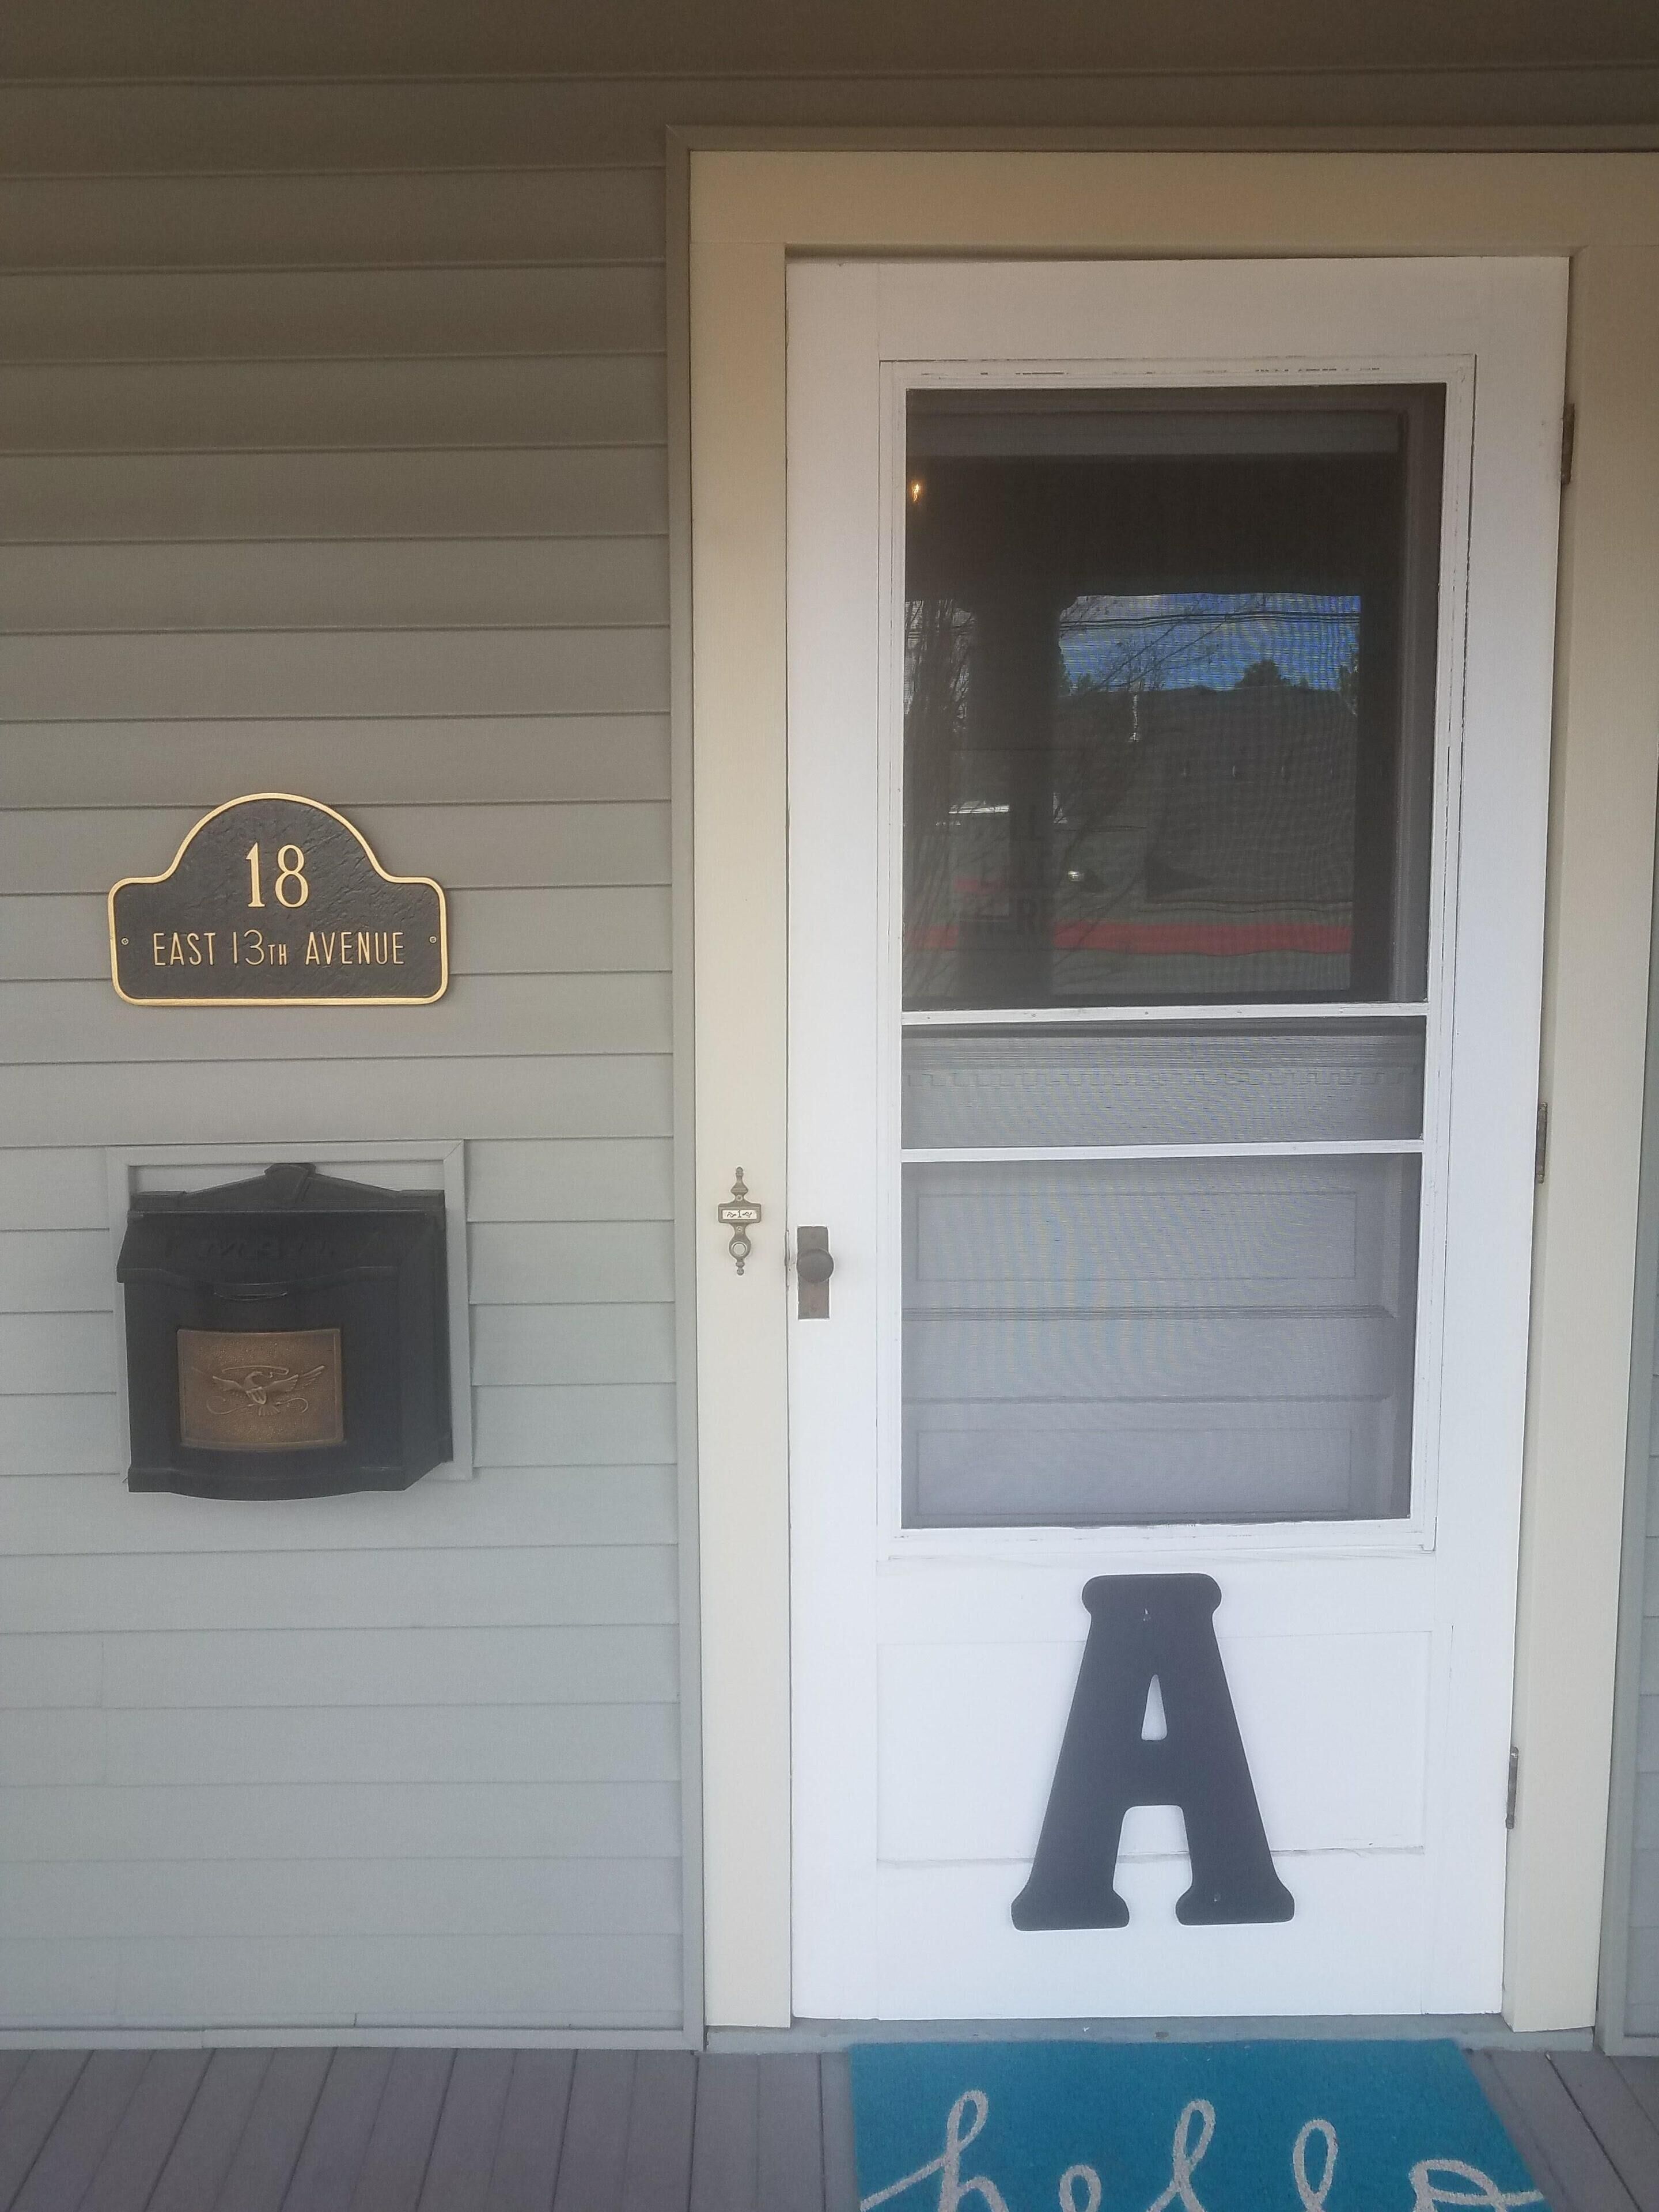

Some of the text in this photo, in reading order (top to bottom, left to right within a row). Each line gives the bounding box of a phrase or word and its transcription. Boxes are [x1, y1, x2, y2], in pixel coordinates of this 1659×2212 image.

[245, 842, 309, 908] 18
[153, 932, 216, 966] EAST
[305, 931, 405, 965] AVENUE
[1011, 1573, 1295, 1931] A
